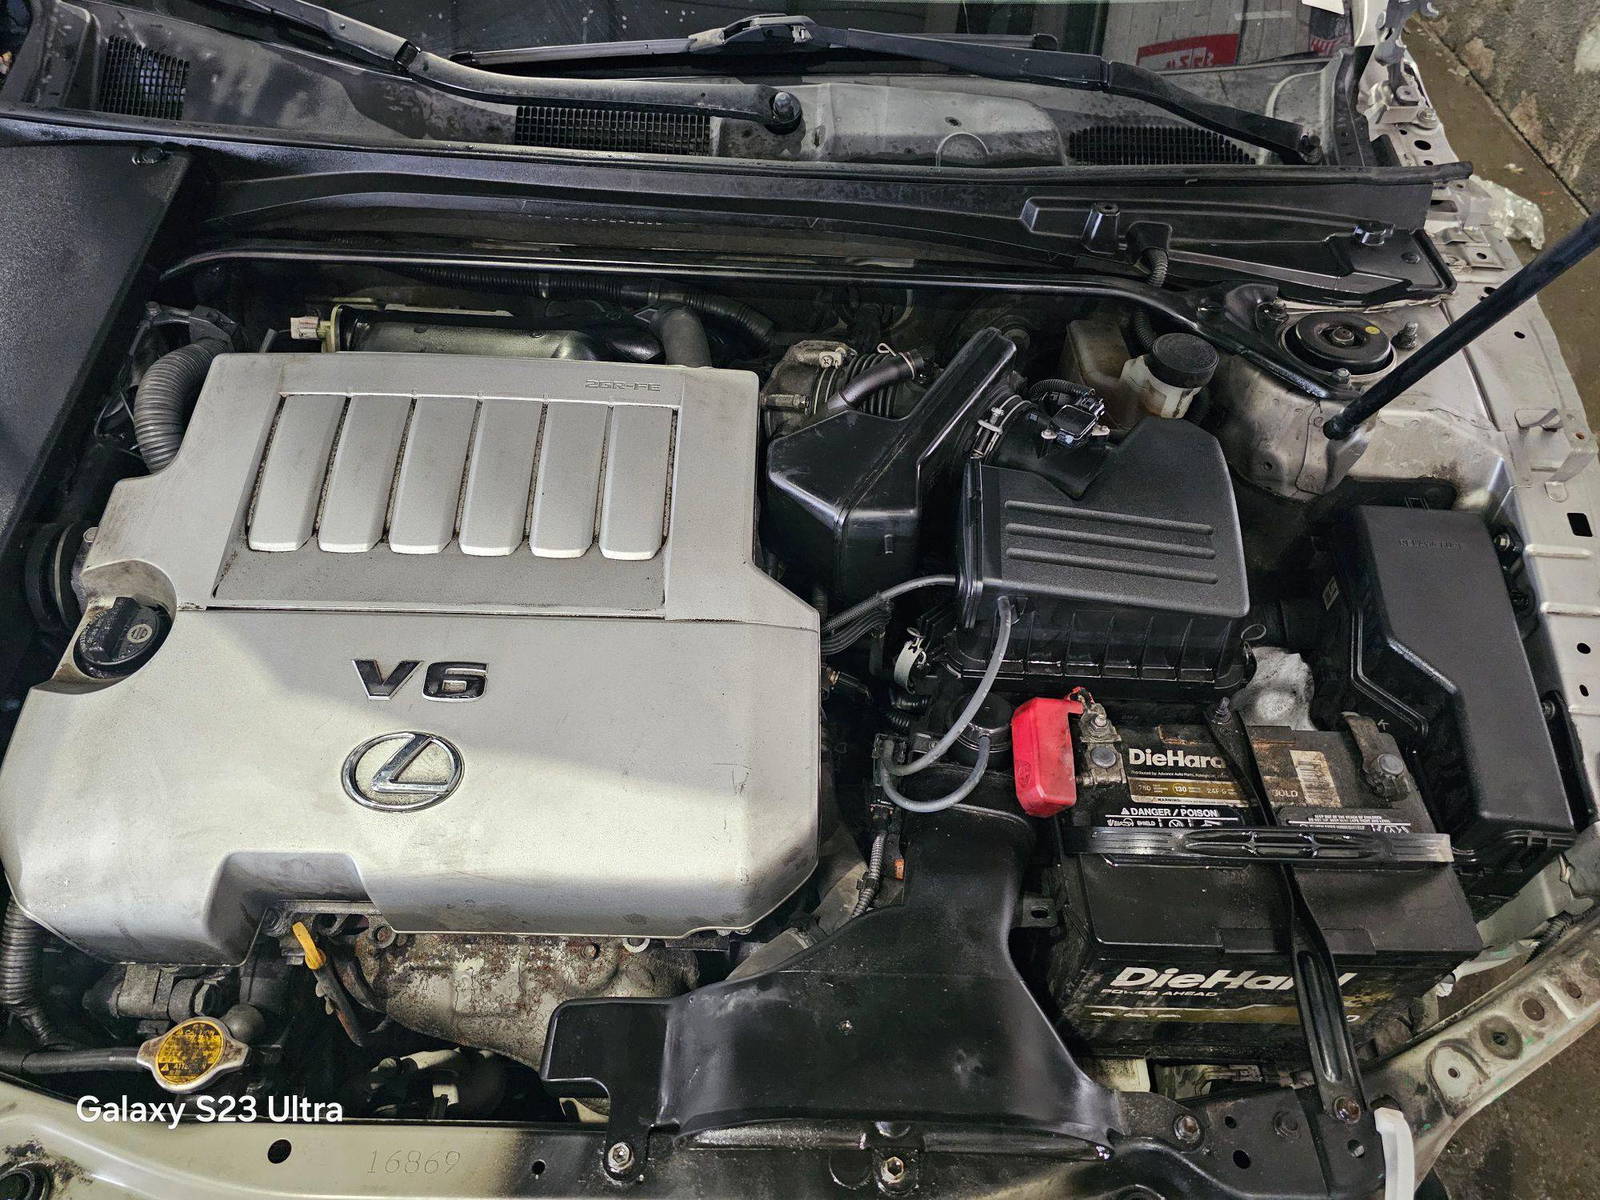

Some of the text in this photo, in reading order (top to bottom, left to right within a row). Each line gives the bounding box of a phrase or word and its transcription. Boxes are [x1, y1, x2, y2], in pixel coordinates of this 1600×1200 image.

[585, 379, 661, 392] 2GR-FE
[352, 659, 489, 702] V6
[1130, 807, 1172, 817] DANGER
[1180, 808, 1219, 818] POISON
[1100, 988, 1218, 998] POWER AHEAD
[367, 1149, 461, 1175] 16869
